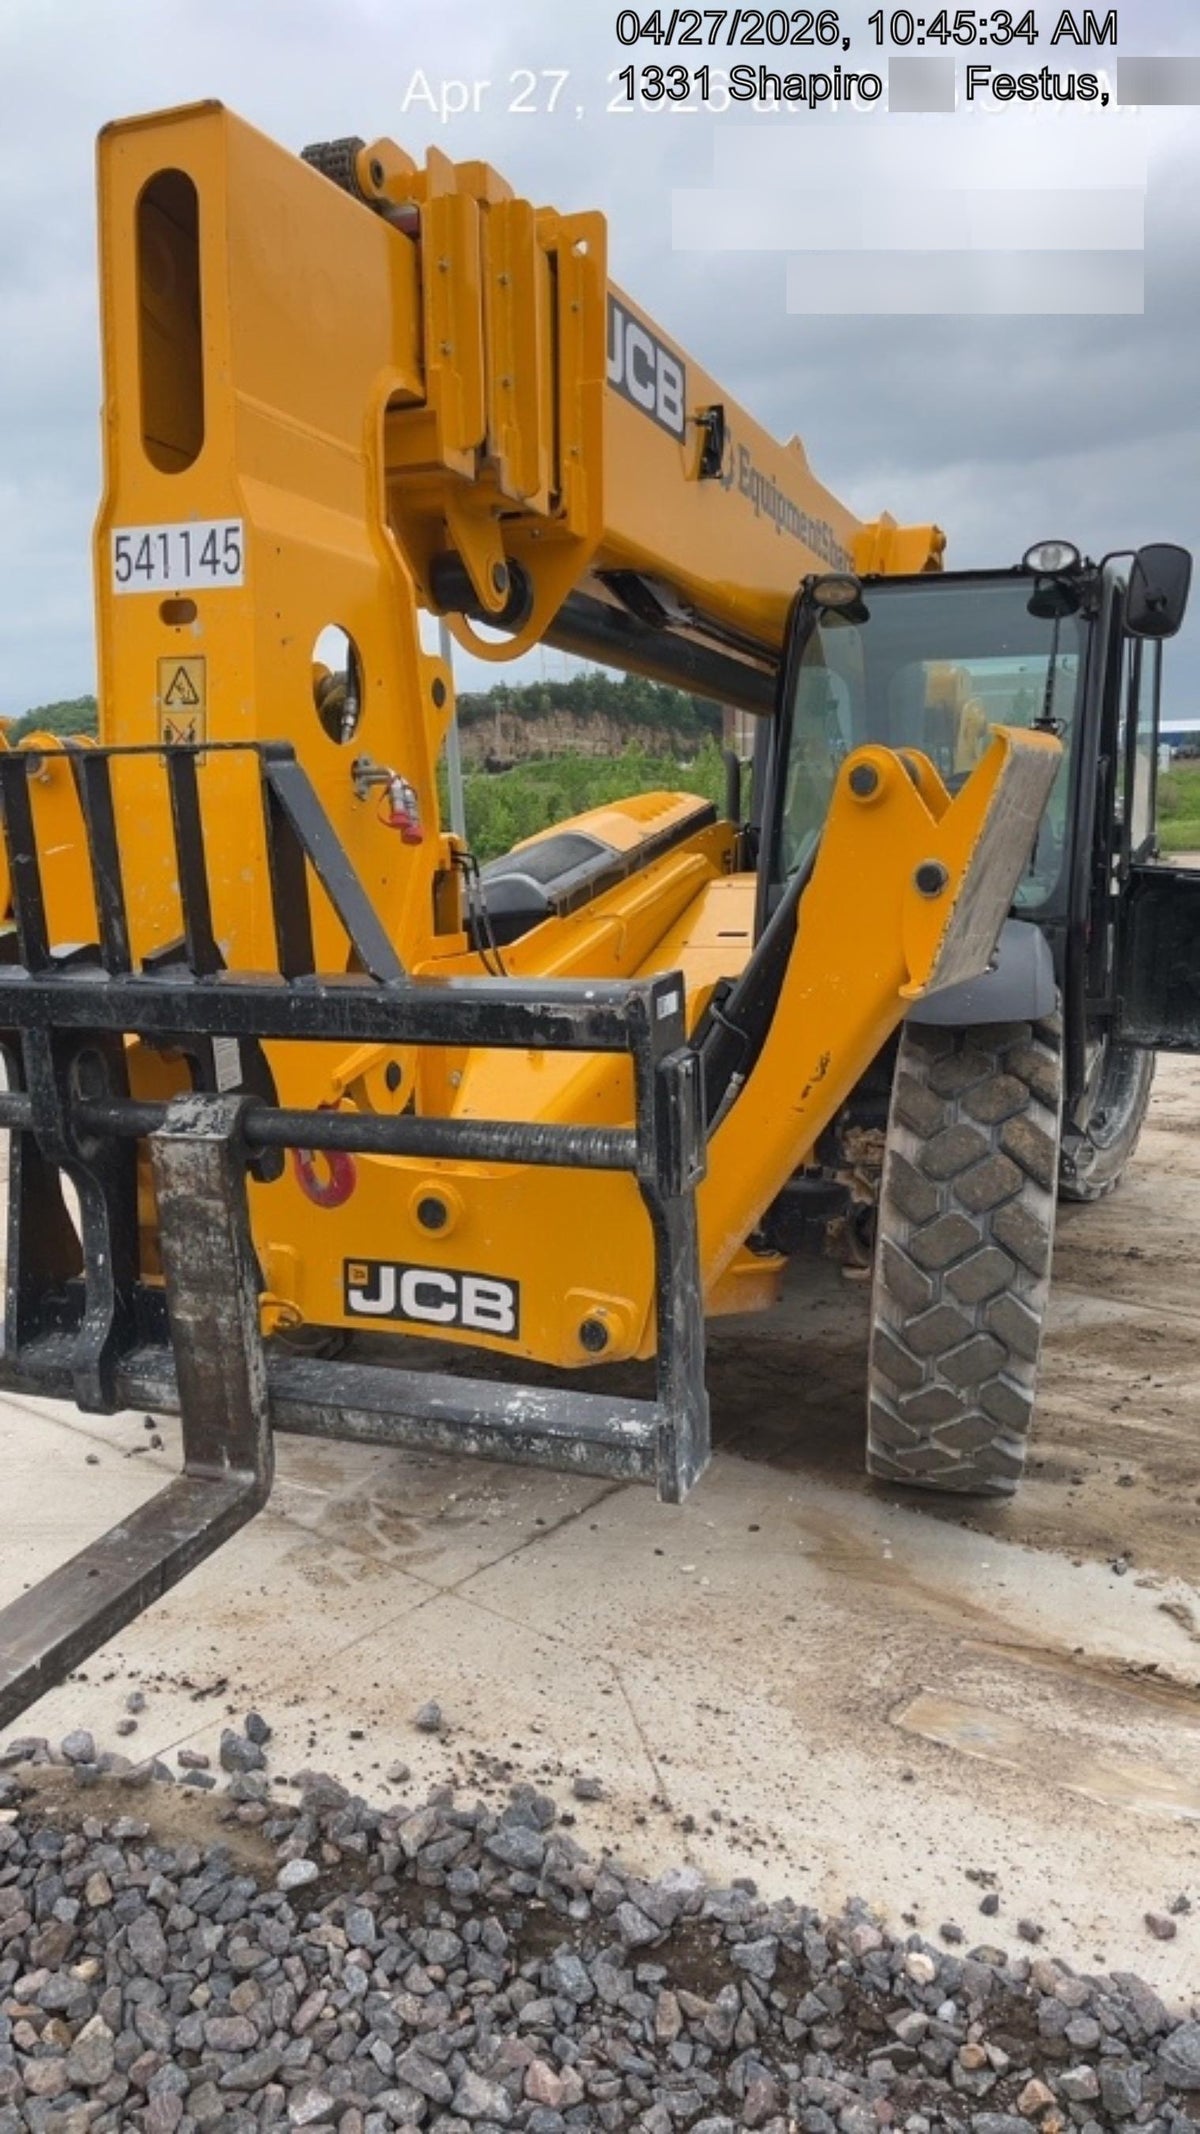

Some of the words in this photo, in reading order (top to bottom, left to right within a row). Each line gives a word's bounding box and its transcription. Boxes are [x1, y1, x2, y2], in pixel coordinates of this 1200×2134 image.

[606, 306, 684, 433] JCB
[115, 526, 241, 582] 541145
[348, 1265, 516, 1334] JCB
